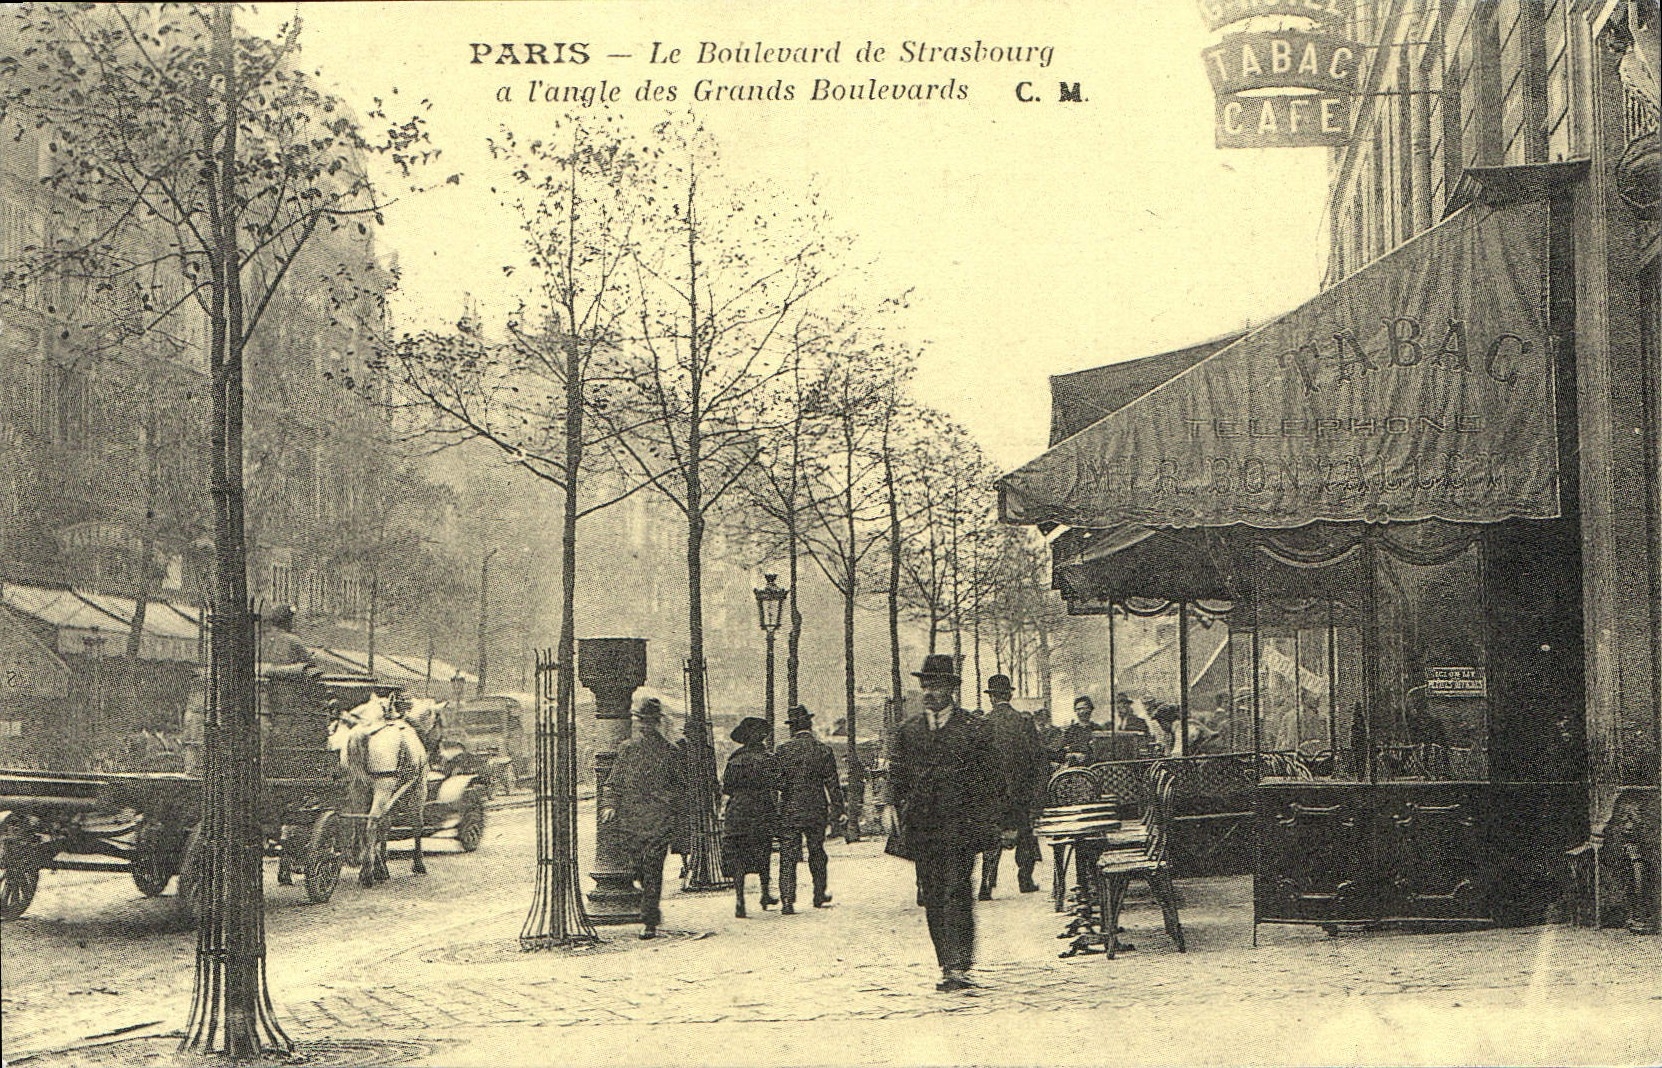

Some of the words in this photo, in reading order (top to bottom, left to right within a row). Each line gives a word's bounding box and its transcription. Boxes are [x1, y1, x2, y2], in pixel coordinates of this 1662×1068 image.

[1209, 41, 1353, 81] TABAC
[1224, 98, 1343, 135] CAFE
[1277, 315, 1532, 397] TABAC
[1185, 415, 1480, 440] TELEPHONE
